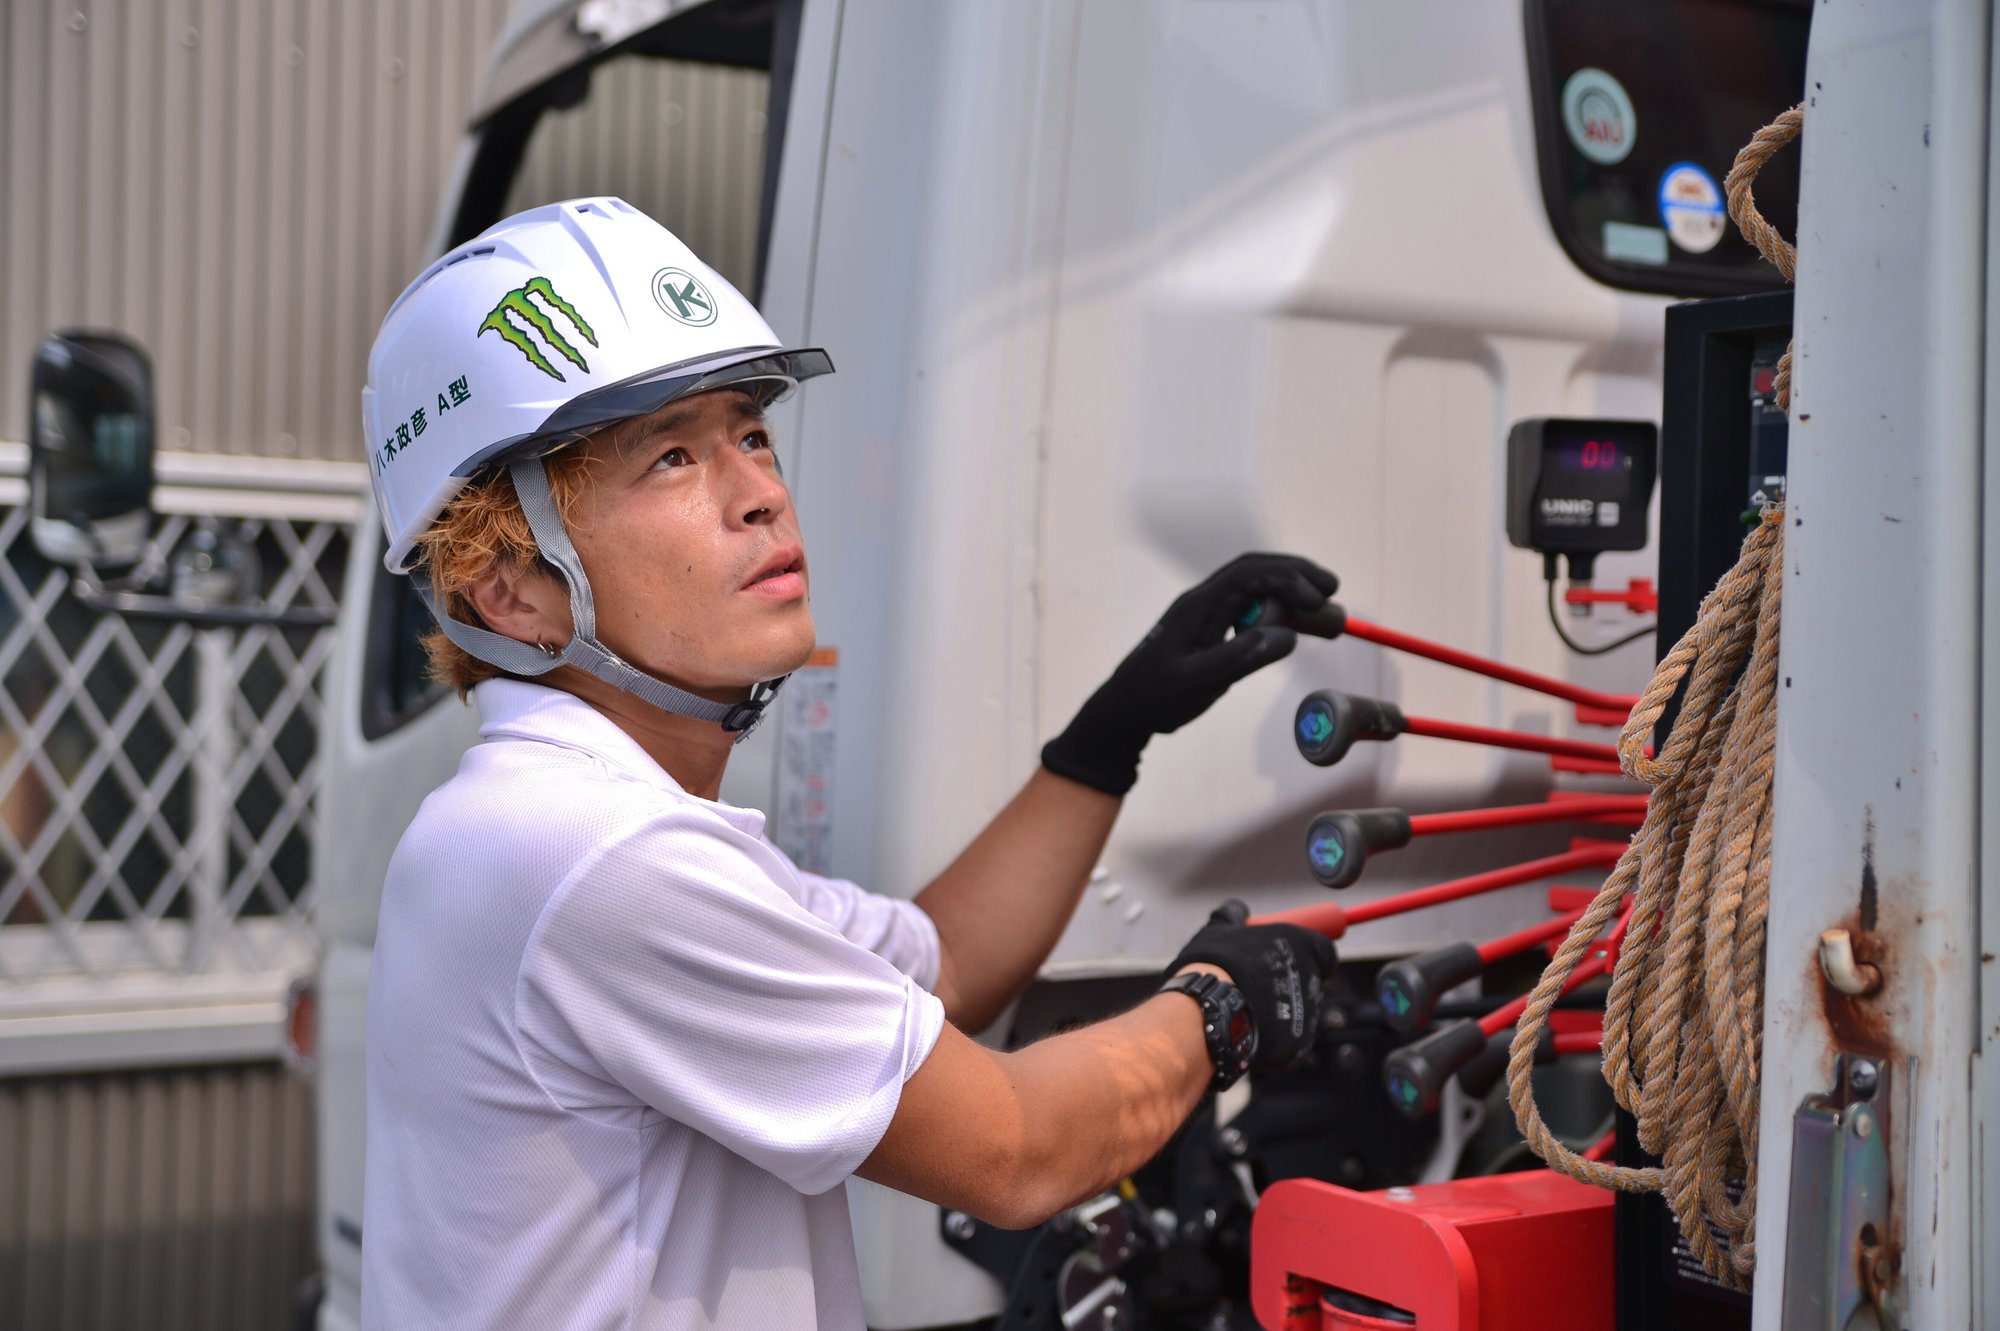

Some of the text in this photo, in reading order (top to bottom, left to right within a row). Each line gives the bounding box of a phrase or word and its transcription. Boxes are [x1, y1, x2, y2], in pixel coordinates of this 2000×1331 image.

[662, 280, 711, 319] K
[376, 374, 472, 477] 八木政彦 A型
[1540, 498, 1594, 517] UNIC
